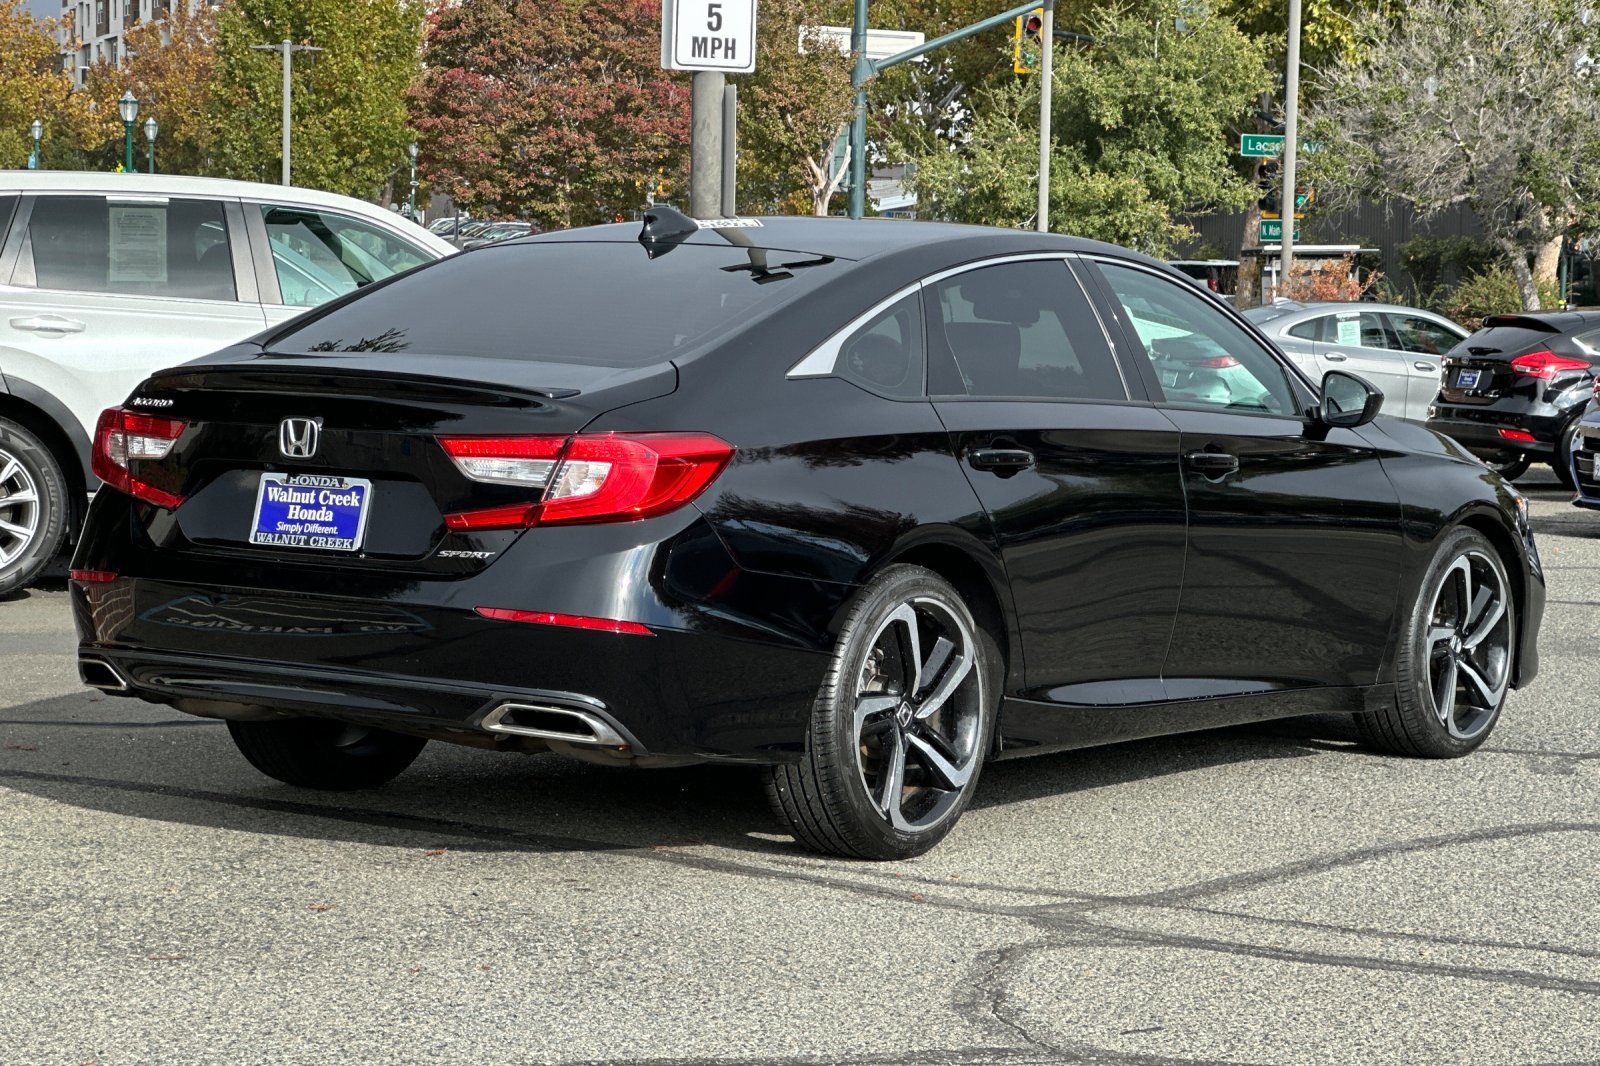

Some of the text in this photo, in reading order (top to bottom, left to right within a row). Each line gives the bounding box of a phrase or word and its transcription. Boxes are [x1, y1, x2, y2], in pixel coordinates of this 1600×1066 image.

[707, 3, 723, 32] 5
[691, 35, 736, 60] MPH
[132, 397, 174, 408] ACCORD
[288, 475, 341, 488] HONDA
[267, 486, 361, 507] Walnut Creek
[287, 504, 334, 522] Honda
[276, 521, 338, 535] Simply Different.
[255, 532, 353, 549] WALNUT CREEK
[437, 550, 496, 559] SPORT
